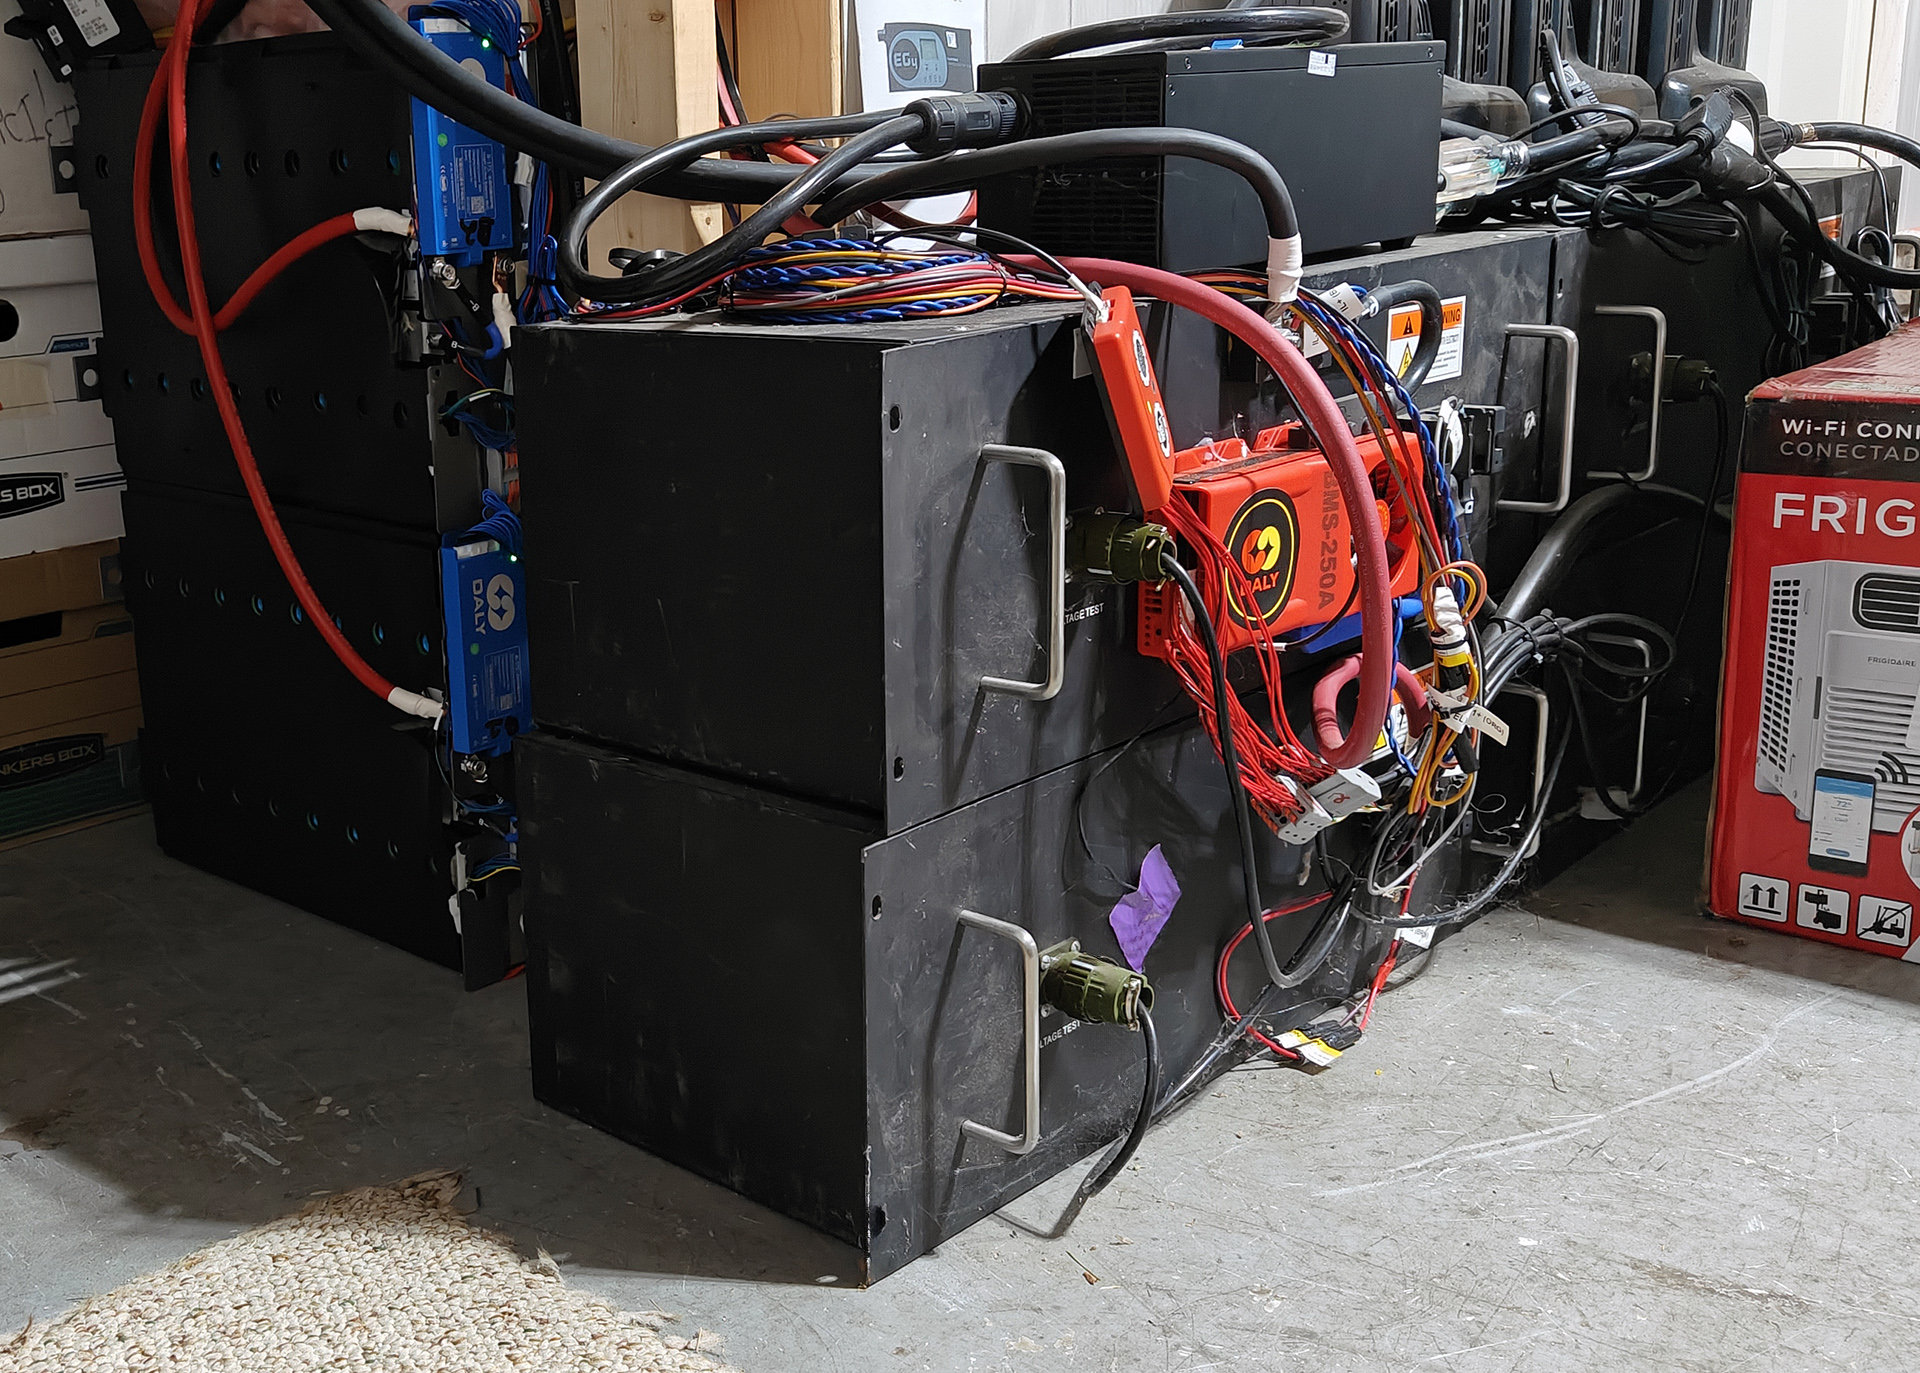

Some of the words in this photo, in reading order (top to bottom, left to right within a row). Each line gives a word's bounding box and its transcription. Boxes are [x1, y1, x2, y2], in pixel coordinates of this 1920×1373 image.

[1781, 418, 1847, 437] Wi-Fi
[1779, 440, 1920, 462] CONECTAD
[16, 482, 56, 500] BOX
[1773, 492, 1916, 537] FRIG
[1318, 470, 1340, 611] BMS-250A
[472, 578, 487, 635] DALY
[1867, 656, 1917, 667] FRIGIDAIRE
[58, 743, 96, 762] BOX
